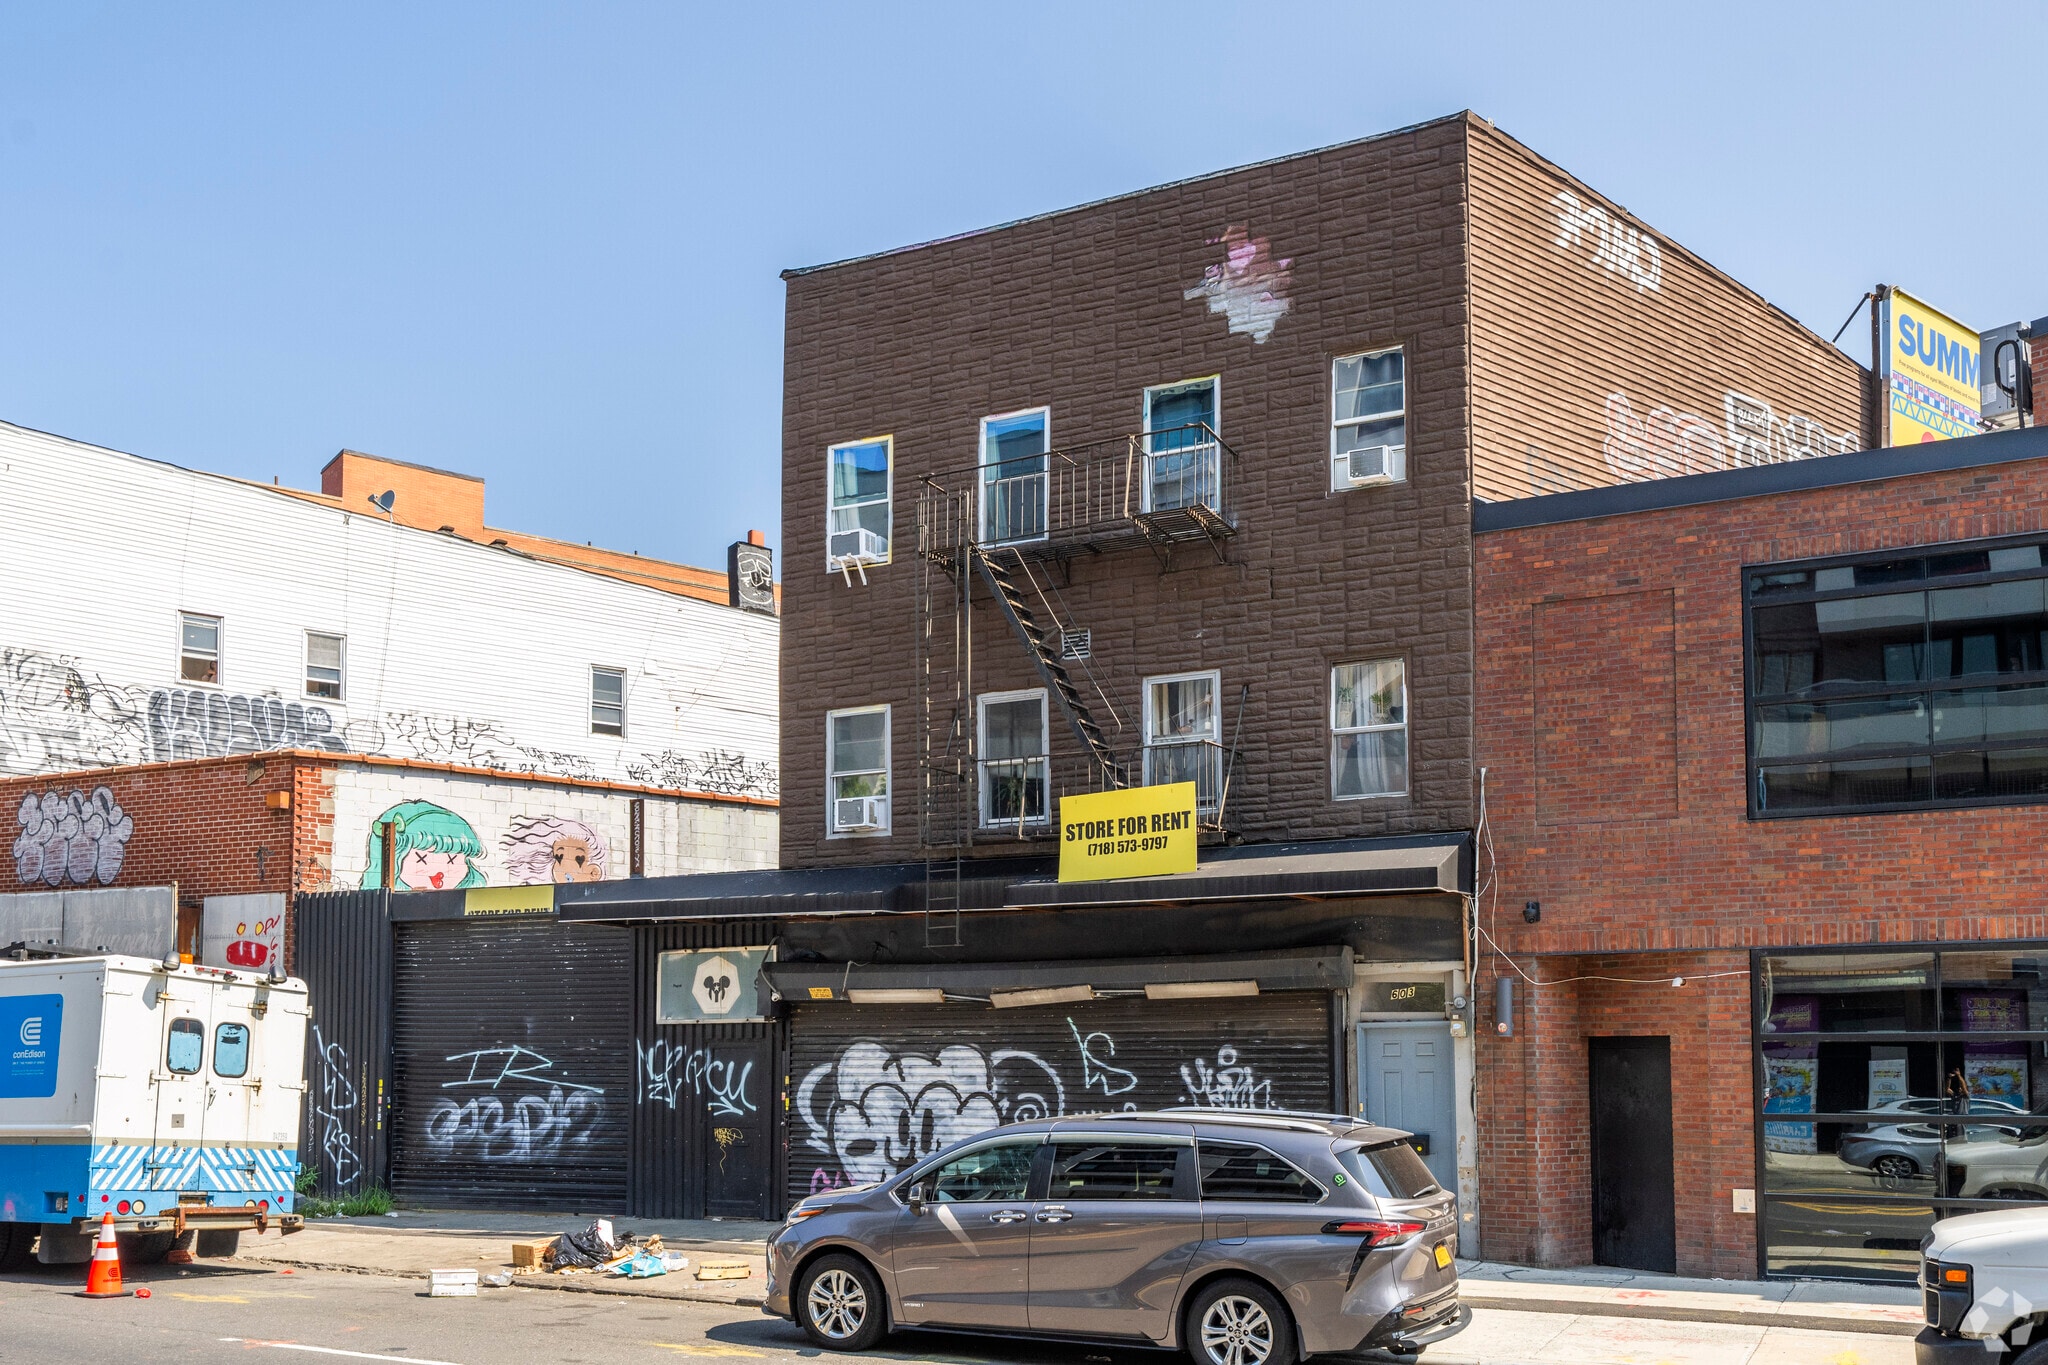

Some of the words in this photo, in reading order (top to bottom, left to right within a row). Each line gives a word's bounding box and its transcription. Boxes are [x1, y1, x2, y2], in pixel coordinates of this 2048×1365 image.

[1906, 364, 1920, 375] programs
[1066, 819, 1114, 842] STORE
[1118, 815, 1147, 836] FOR
[1151, 810, 1191, 833] RENT
[1087, 841, 1114, 856] (718)
[1117, 836, 1168, 854] 573-9797
[1391, 987, 1415, 1000] 603
[12, 1049, 46, 1059] conEdison
